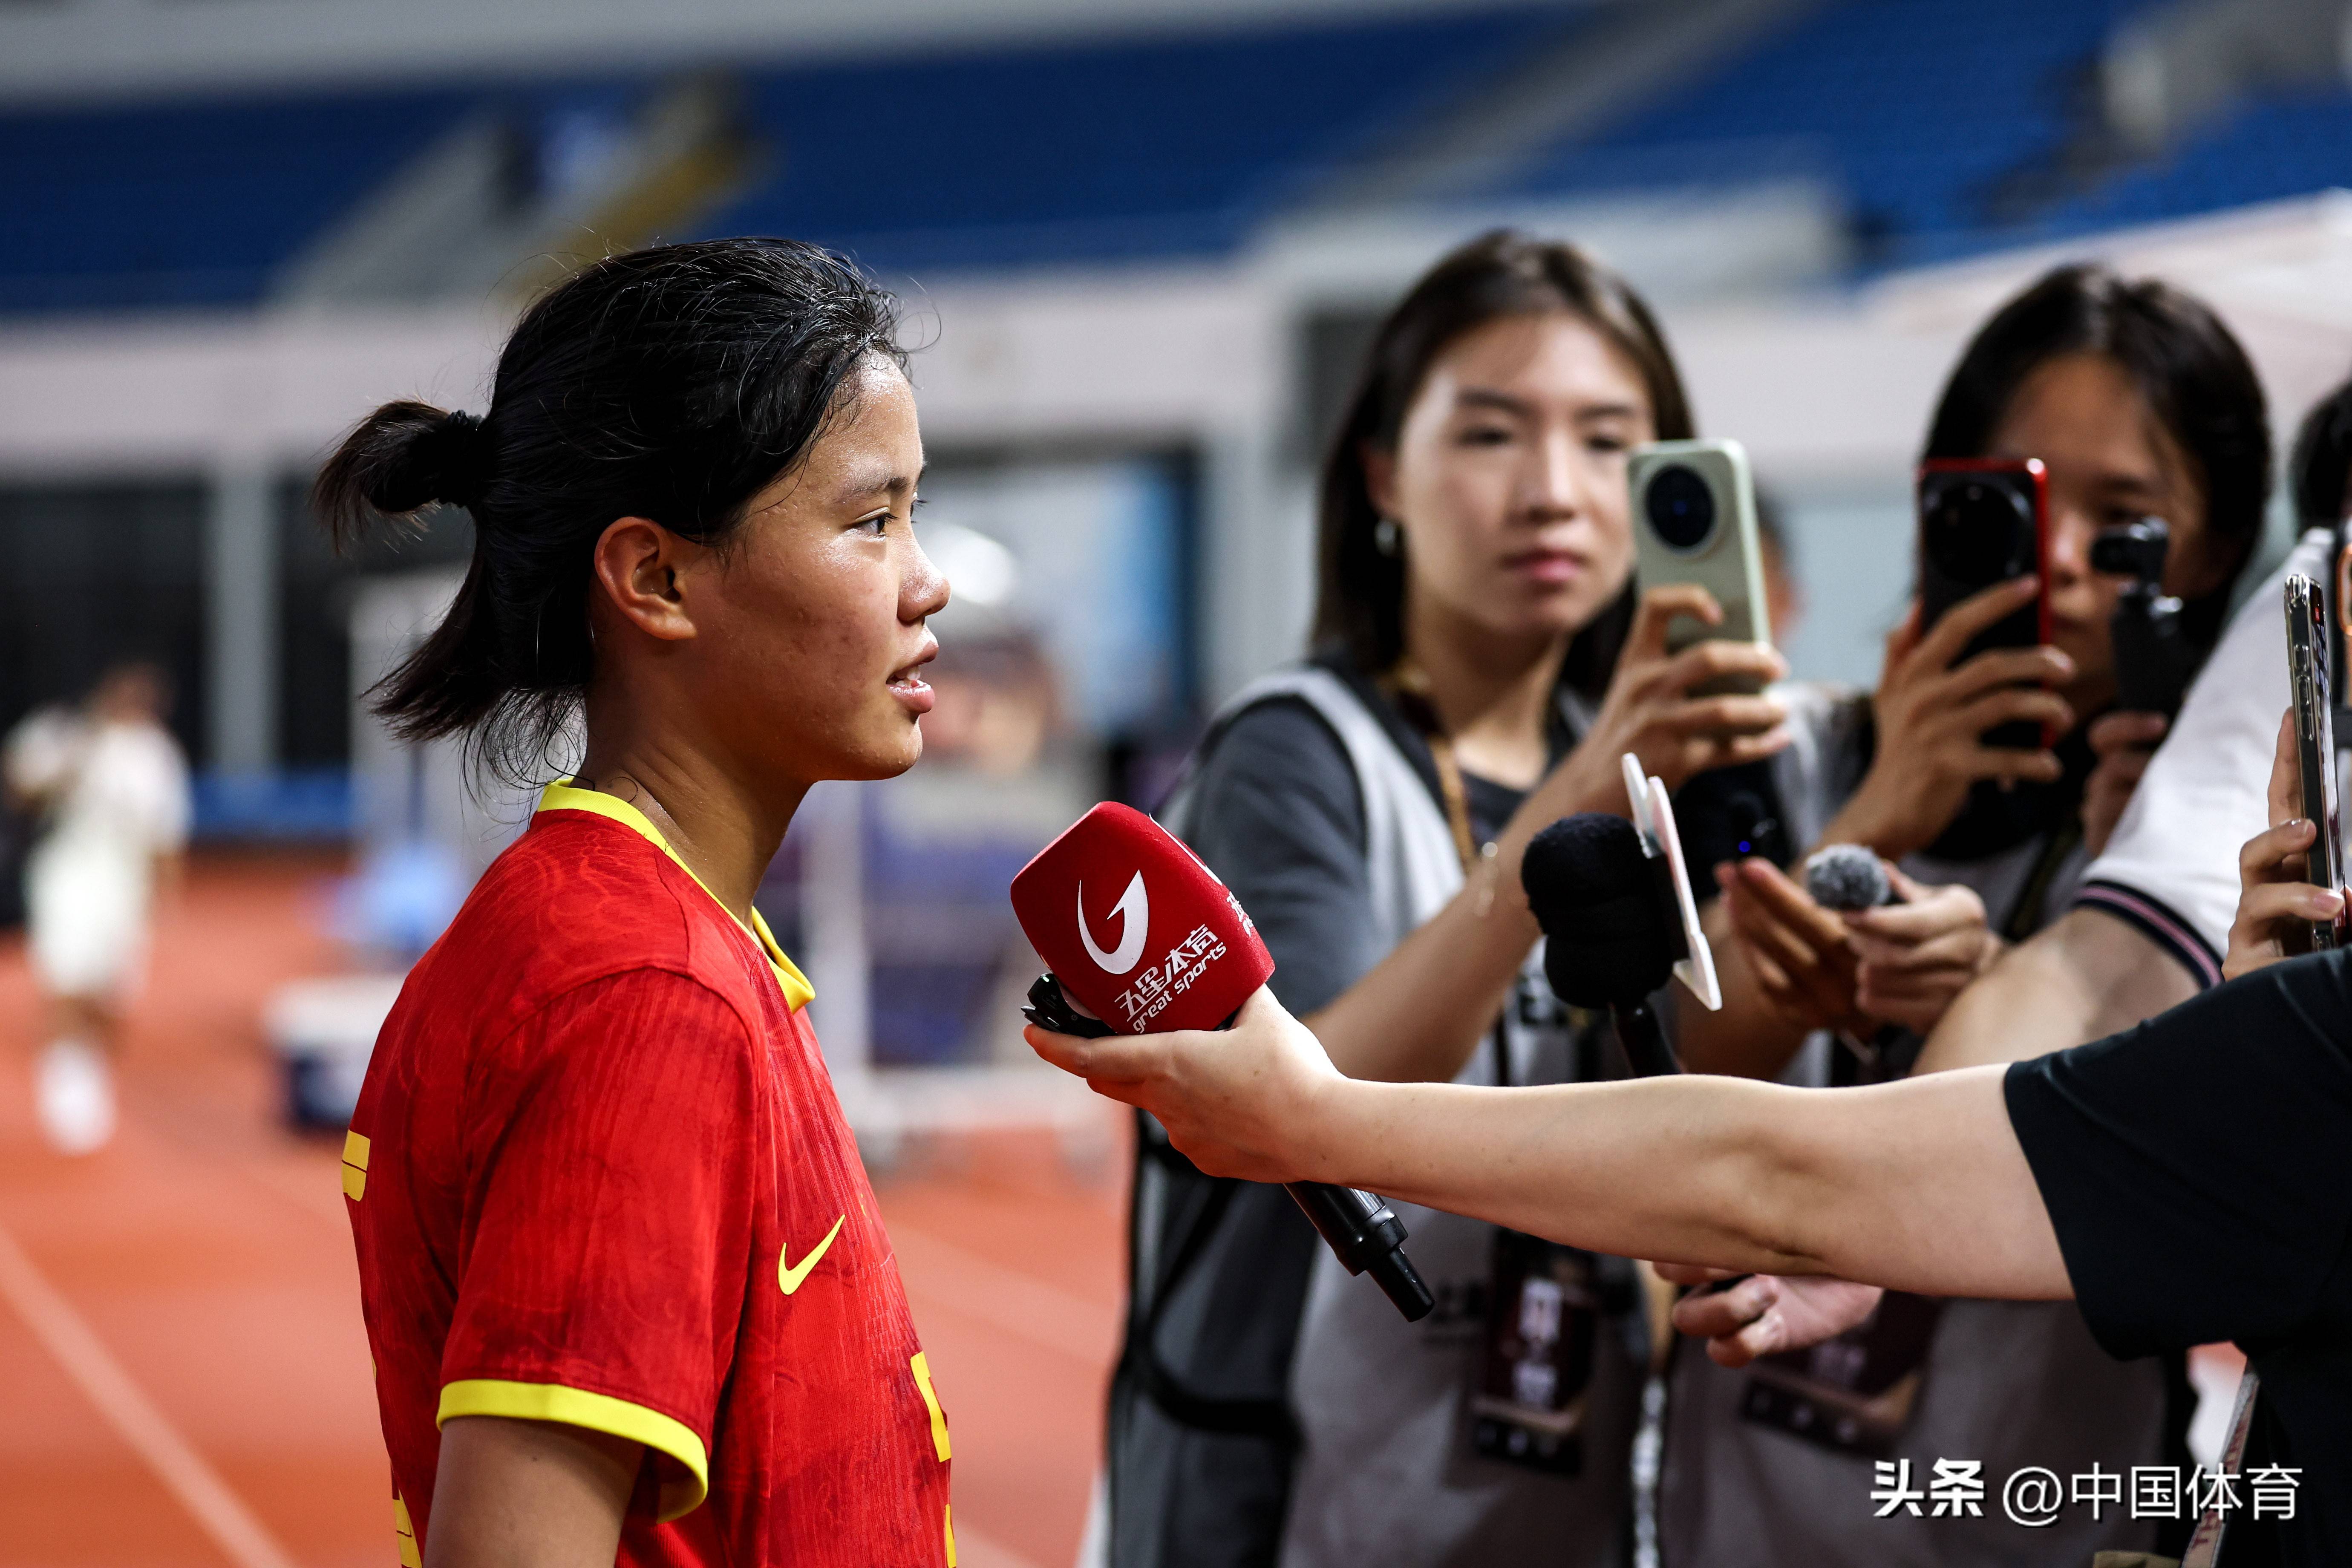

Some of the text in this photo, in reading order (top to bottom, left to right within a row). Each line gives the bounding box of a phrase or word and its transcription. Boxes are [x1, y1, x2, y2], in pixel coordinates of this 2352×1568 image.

[1114, 923, 1219, 1022] 五星体育
[1133, 942, 1227, 1034] great sports
